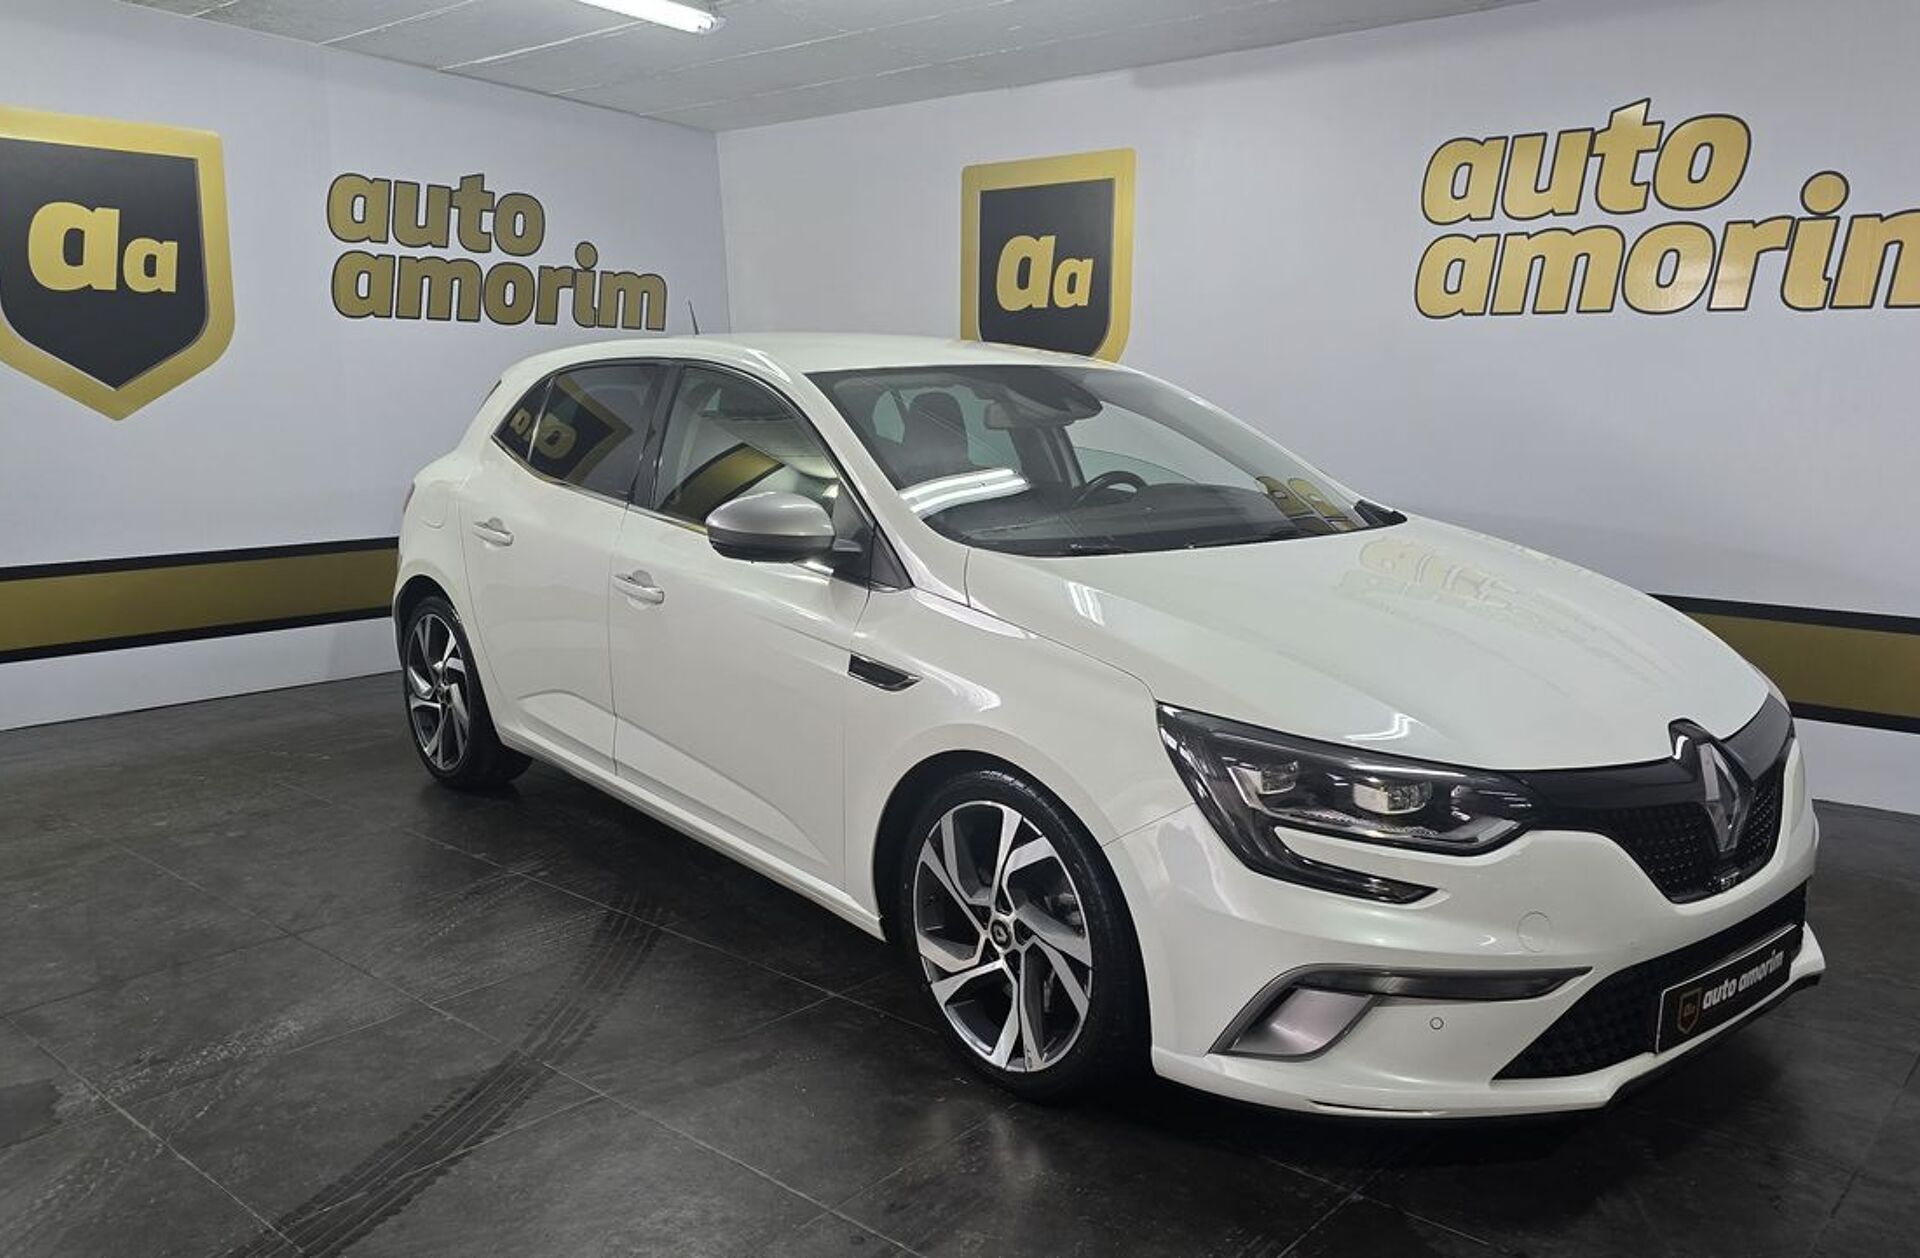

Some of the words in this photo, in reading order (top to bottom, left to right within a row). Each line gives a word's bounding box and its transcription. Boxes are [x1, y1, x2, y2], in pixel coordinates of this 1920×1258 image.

[1421, 98, 1751, 225] auto
[327, 172, 545, 254] auto
[331, 241, 667, 331] amorim
[1702, 977, 1738, 1009] auto
[1738, 950, 1784, 992] amorim
